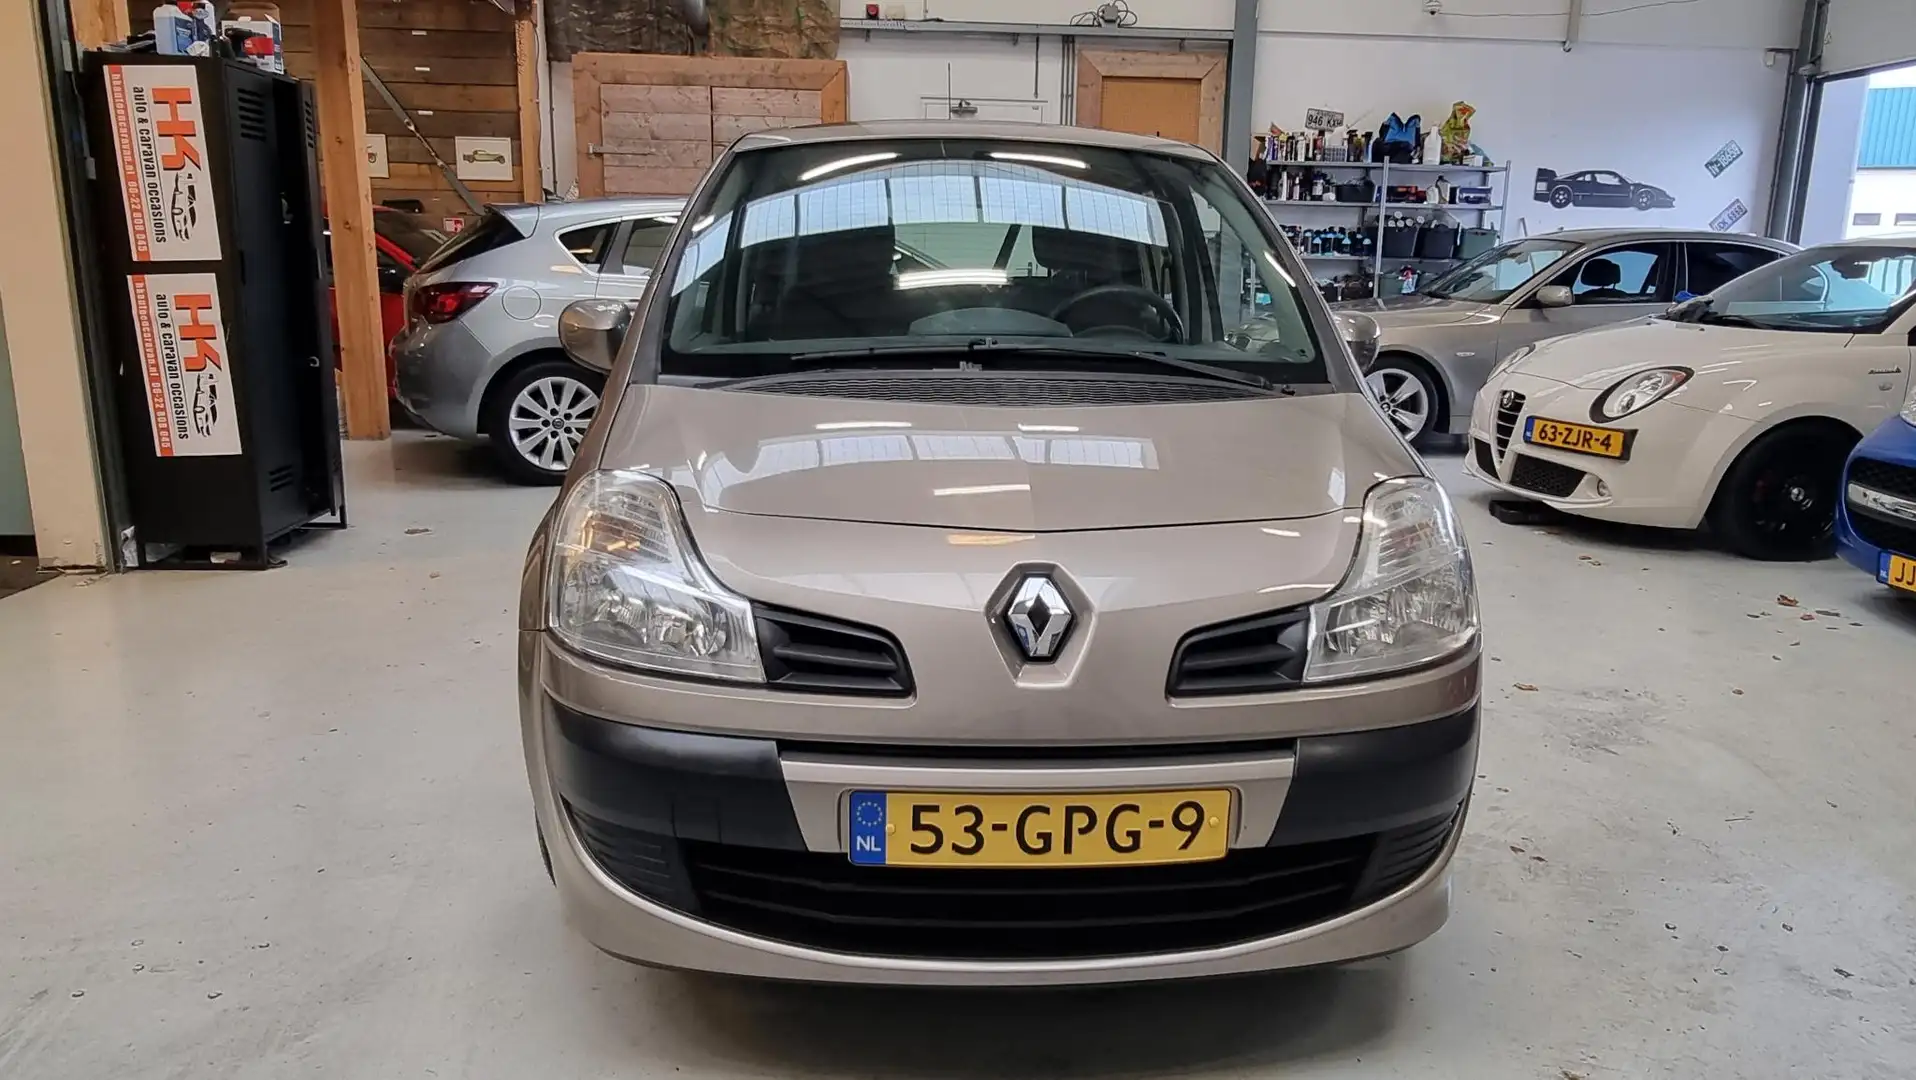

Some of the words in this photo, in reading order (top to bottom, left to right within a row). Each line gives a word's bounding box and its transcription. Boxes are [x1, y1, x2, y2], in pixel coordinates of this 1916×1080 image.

[133, 86, 147, 113] auto
[139, 128, 157, 178] caravan
[151, 87, 202, 171] HK
[147, 182, 167, 243] occasions
[155, 293, 169, 319] auto
[162, 332, 180, 381] caravan
[173, 293, 223, 373] HK
[170, 382, 189, 440] occasions
[1538, 423, 1612, 452] 63-ZJR-4
[856, 835, 882, 852] NL
[909, 800, 1206, 856] 53-GPG-9
